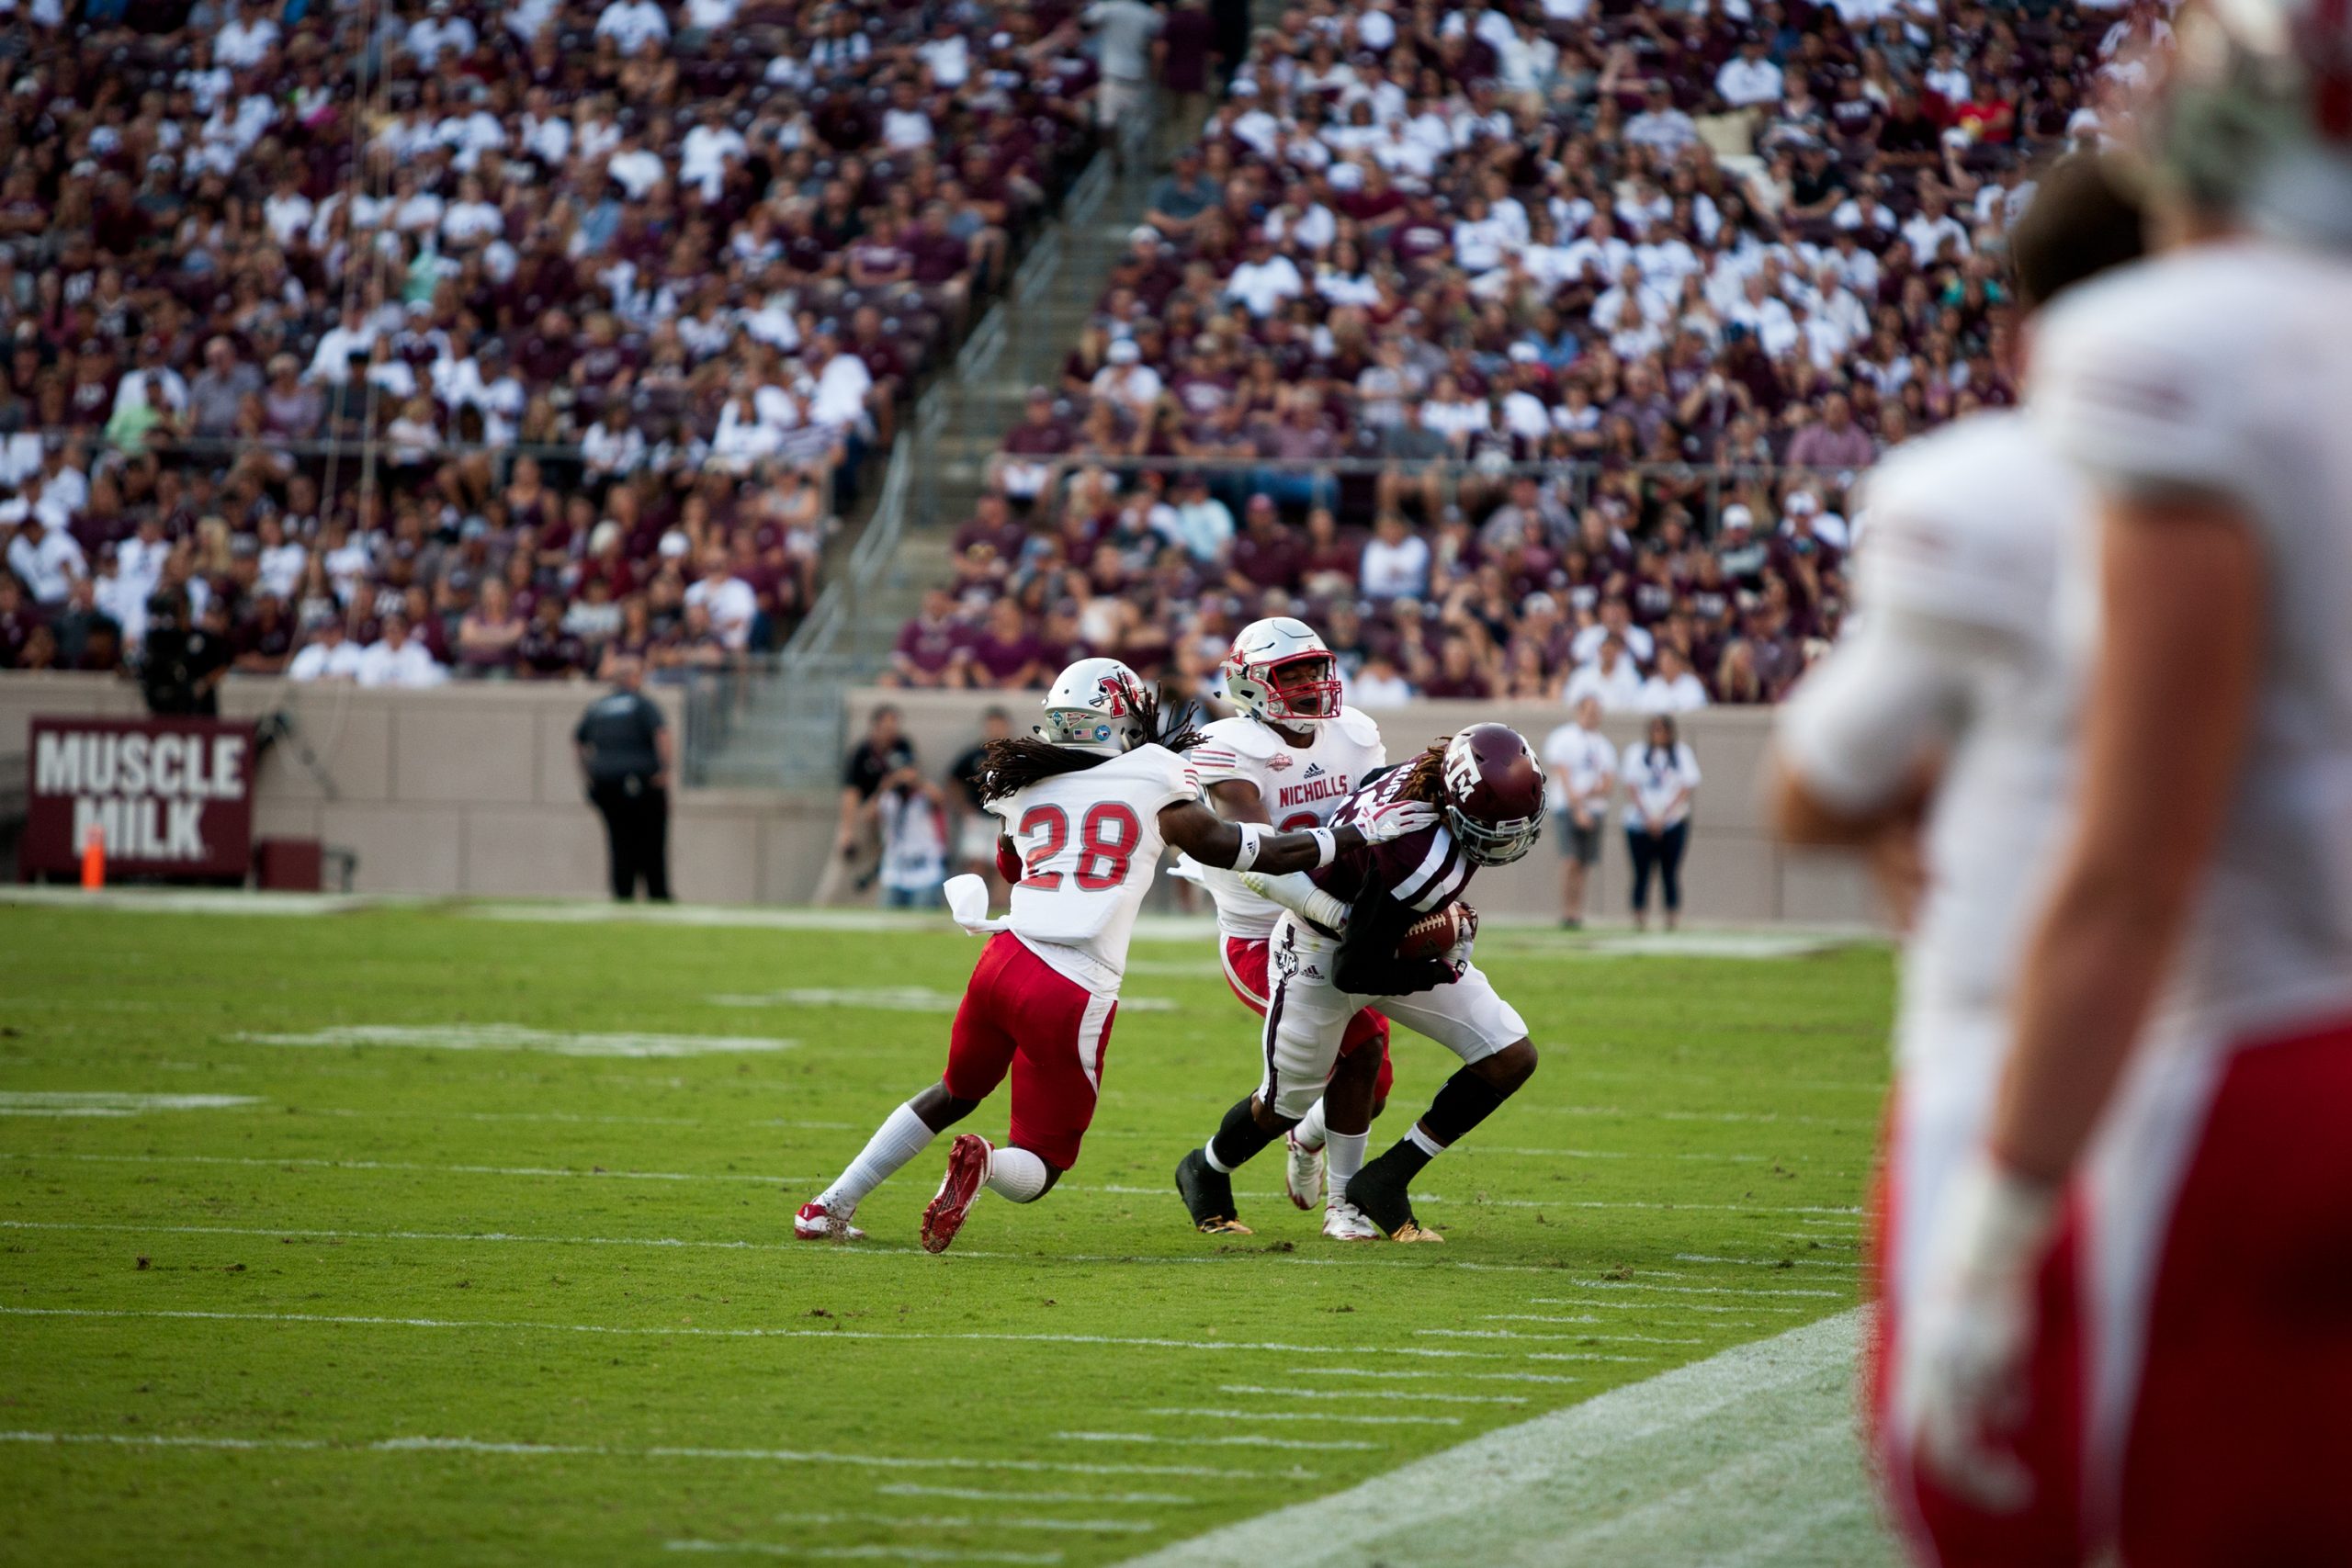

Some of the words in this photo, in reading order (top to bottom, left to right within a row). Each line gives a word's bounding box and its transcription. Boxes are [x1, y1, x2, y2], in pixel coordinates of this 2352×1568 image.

[36, 731, 246, 799] MUSCLE
[1279, 774, 1348, 808] NICHOLLS
[73, 795, 205, 861] MILK
[1015, 800, 1143, 892] 28
